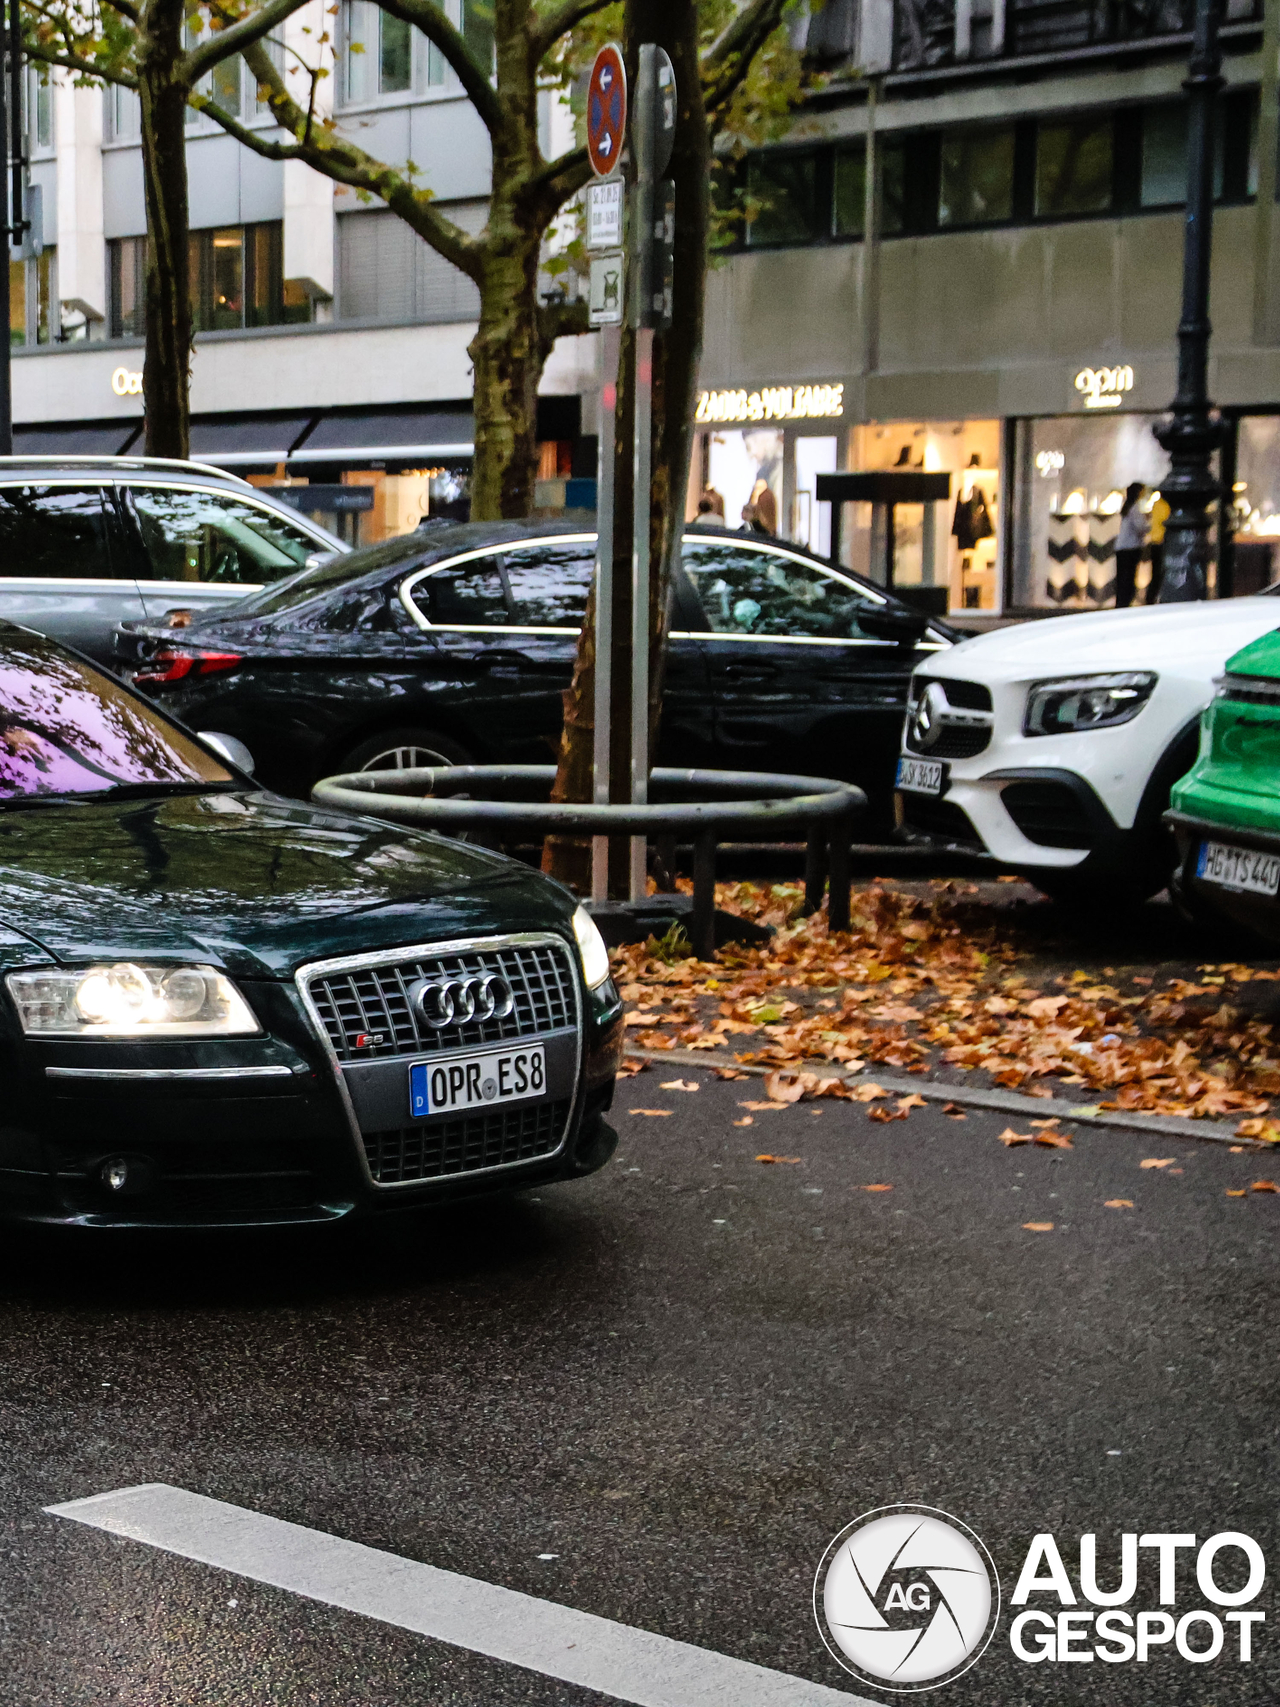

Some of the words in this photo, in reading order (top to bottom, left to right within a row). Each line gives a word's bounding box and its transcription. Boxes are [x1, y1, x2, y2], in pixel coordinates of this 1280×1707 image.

[416, 1095, 424, 1108] D
[431, 1062, 483, 1107] OPR
[498, 1051, 544, 1096] ES8
